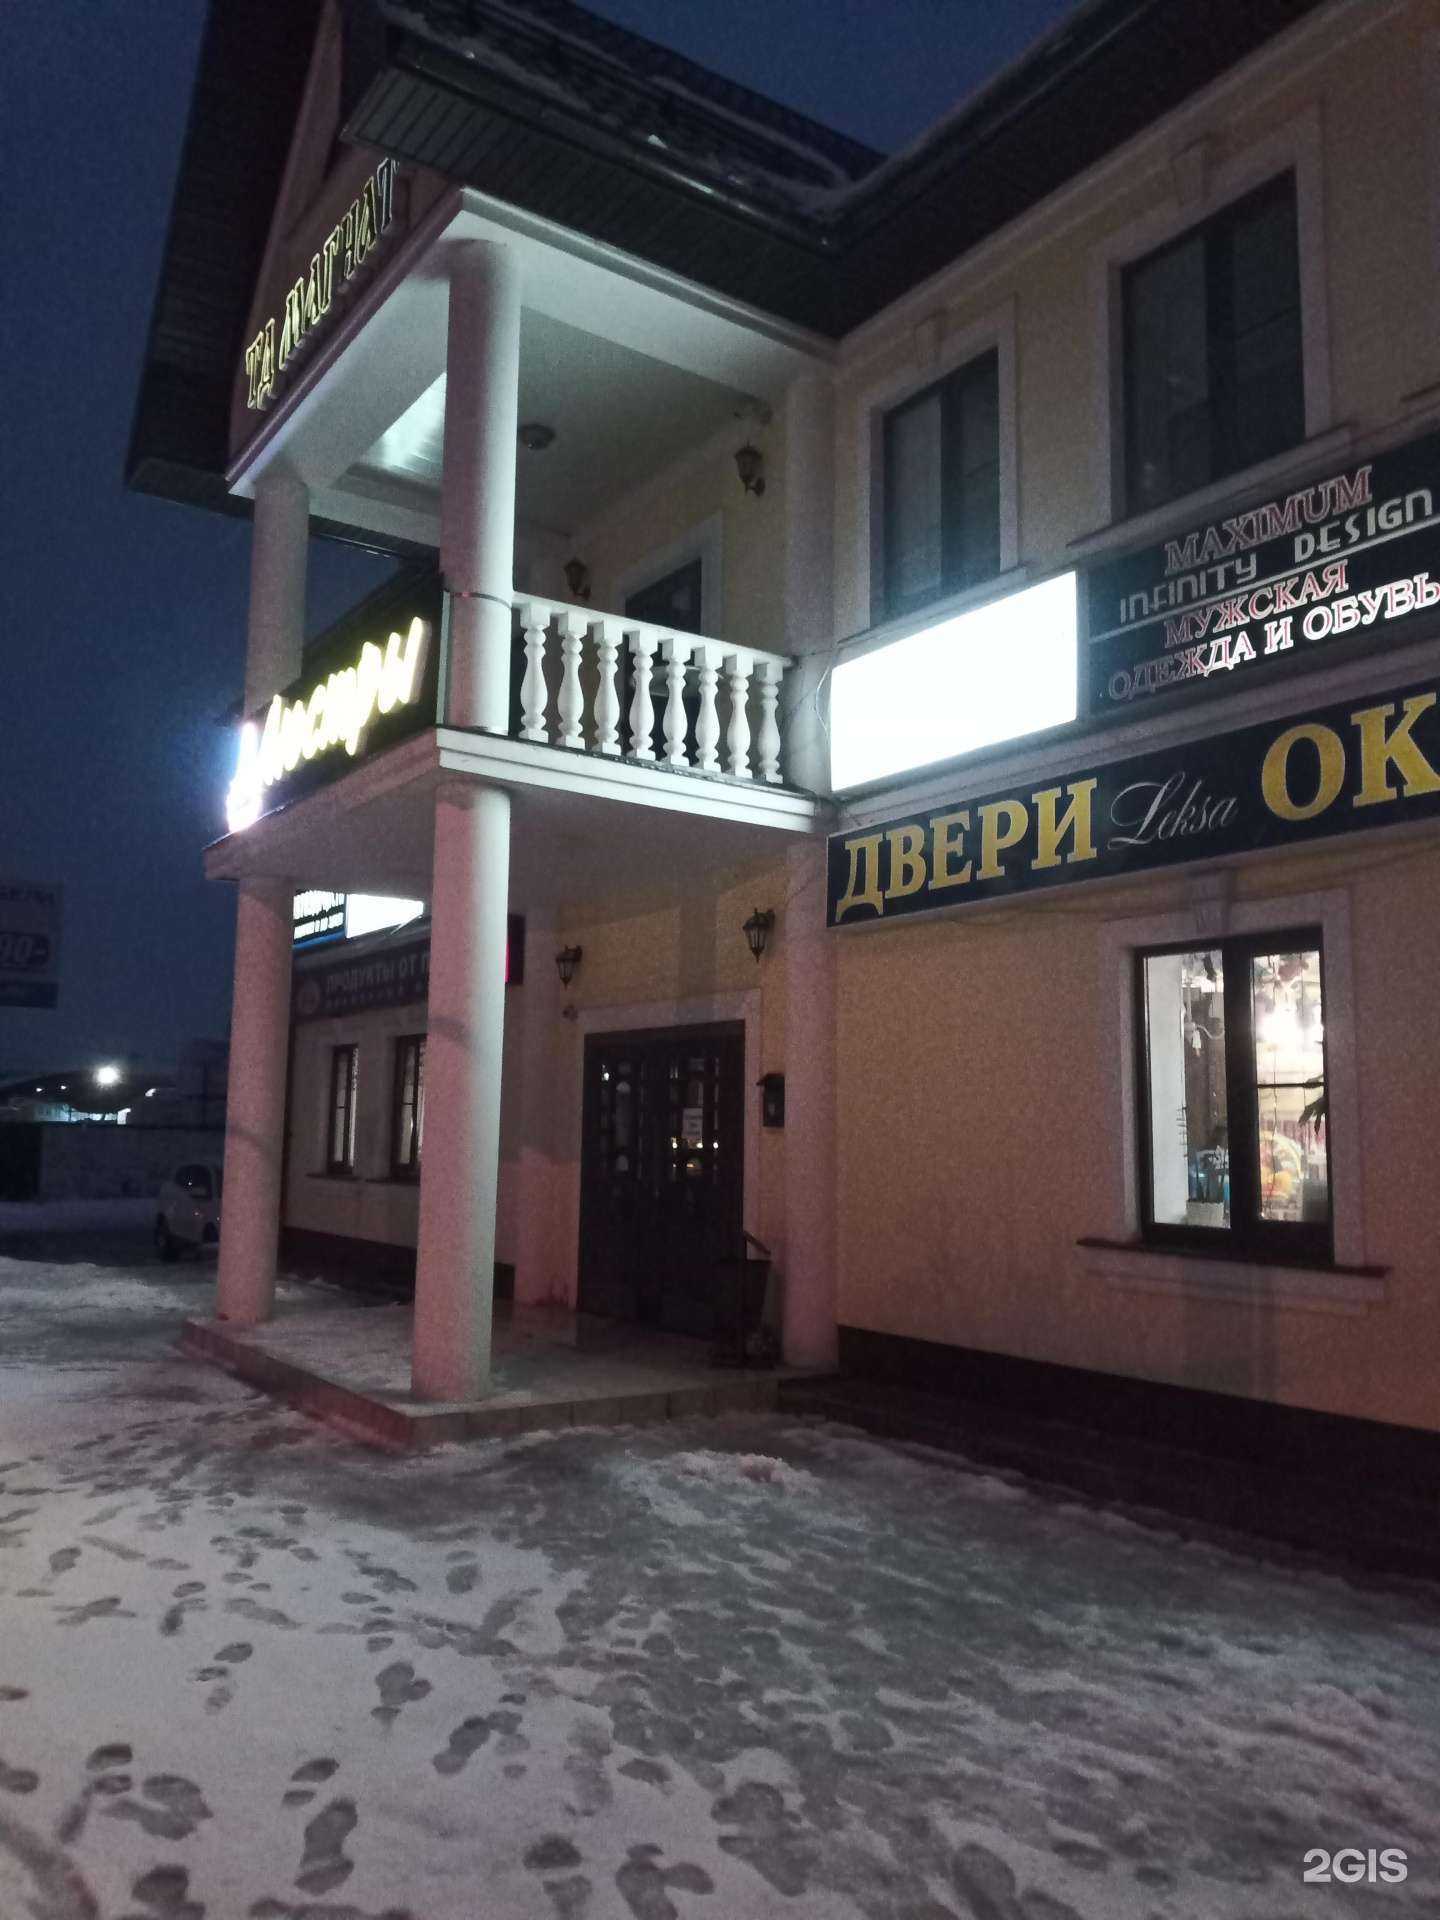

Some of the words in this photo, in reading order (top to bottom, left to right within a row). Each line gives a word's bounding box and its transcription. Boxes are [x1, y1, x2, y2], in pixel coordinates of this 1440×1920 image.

[1164, 465, 1373, 576] MAXIMUM
[1109, 631, 1257, 699] ОДЕЖДА
[1264, 616, 1293, 654] И
[1303, 572, 1440, 641] ОБУВЬ
[1164, 559, 1350, 648] МУЖСКАЯ
[835, 777, 1099, 923] ДВЕРИ
